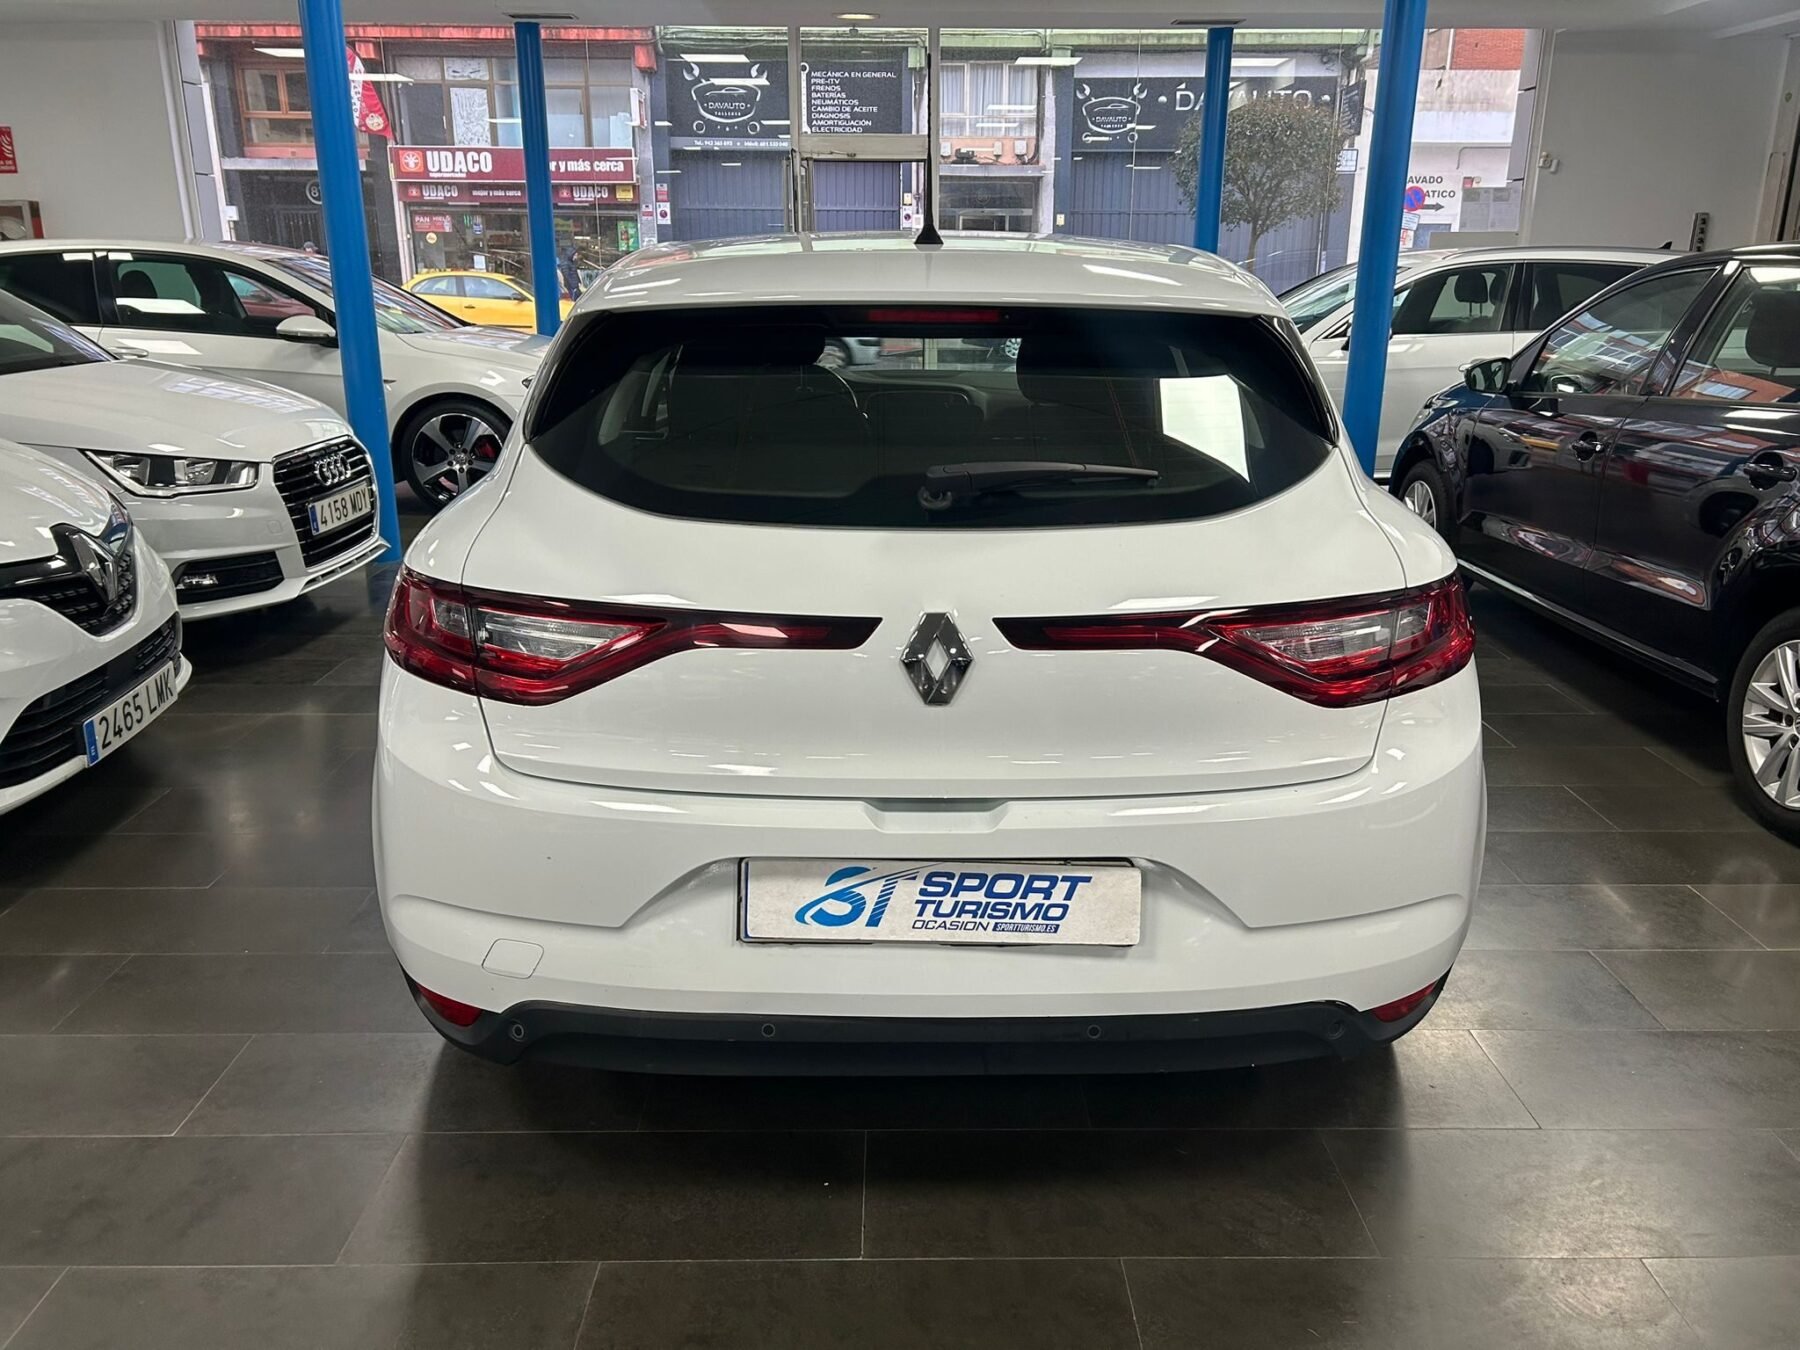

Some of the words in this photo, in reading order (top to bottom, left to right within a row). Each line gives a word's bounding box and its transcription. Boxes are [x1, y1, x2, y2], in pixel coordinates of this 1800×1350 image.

[708, 102, 746, 110] DAVAUTO
[426, 150, 493, 173] UDACO
[559, 161, 566, 173] y
[567, 159, 591, 172] más
[593, 161, 625, 172] cerca
[1407, 176, 1443, 184] AVADO
[422, 185, 458, 197] UDACO
[572, 186, 608, 198] UDACO
[1424, 190, 1456, 198] ATICO
[320, 497, 348, 527] 4158
[349, 487, 367, 515] MDY
[99, 692, 143, 750] 2465
[146, 668, 173, 715] LMK
[918, 871, 1092, 900] SPORT
[915, 900, 1069, 921] TURISMO
[912, 919, 990, 931] OCASION
[995, 923, 1057, 933] SPORTTURISMO.ES
